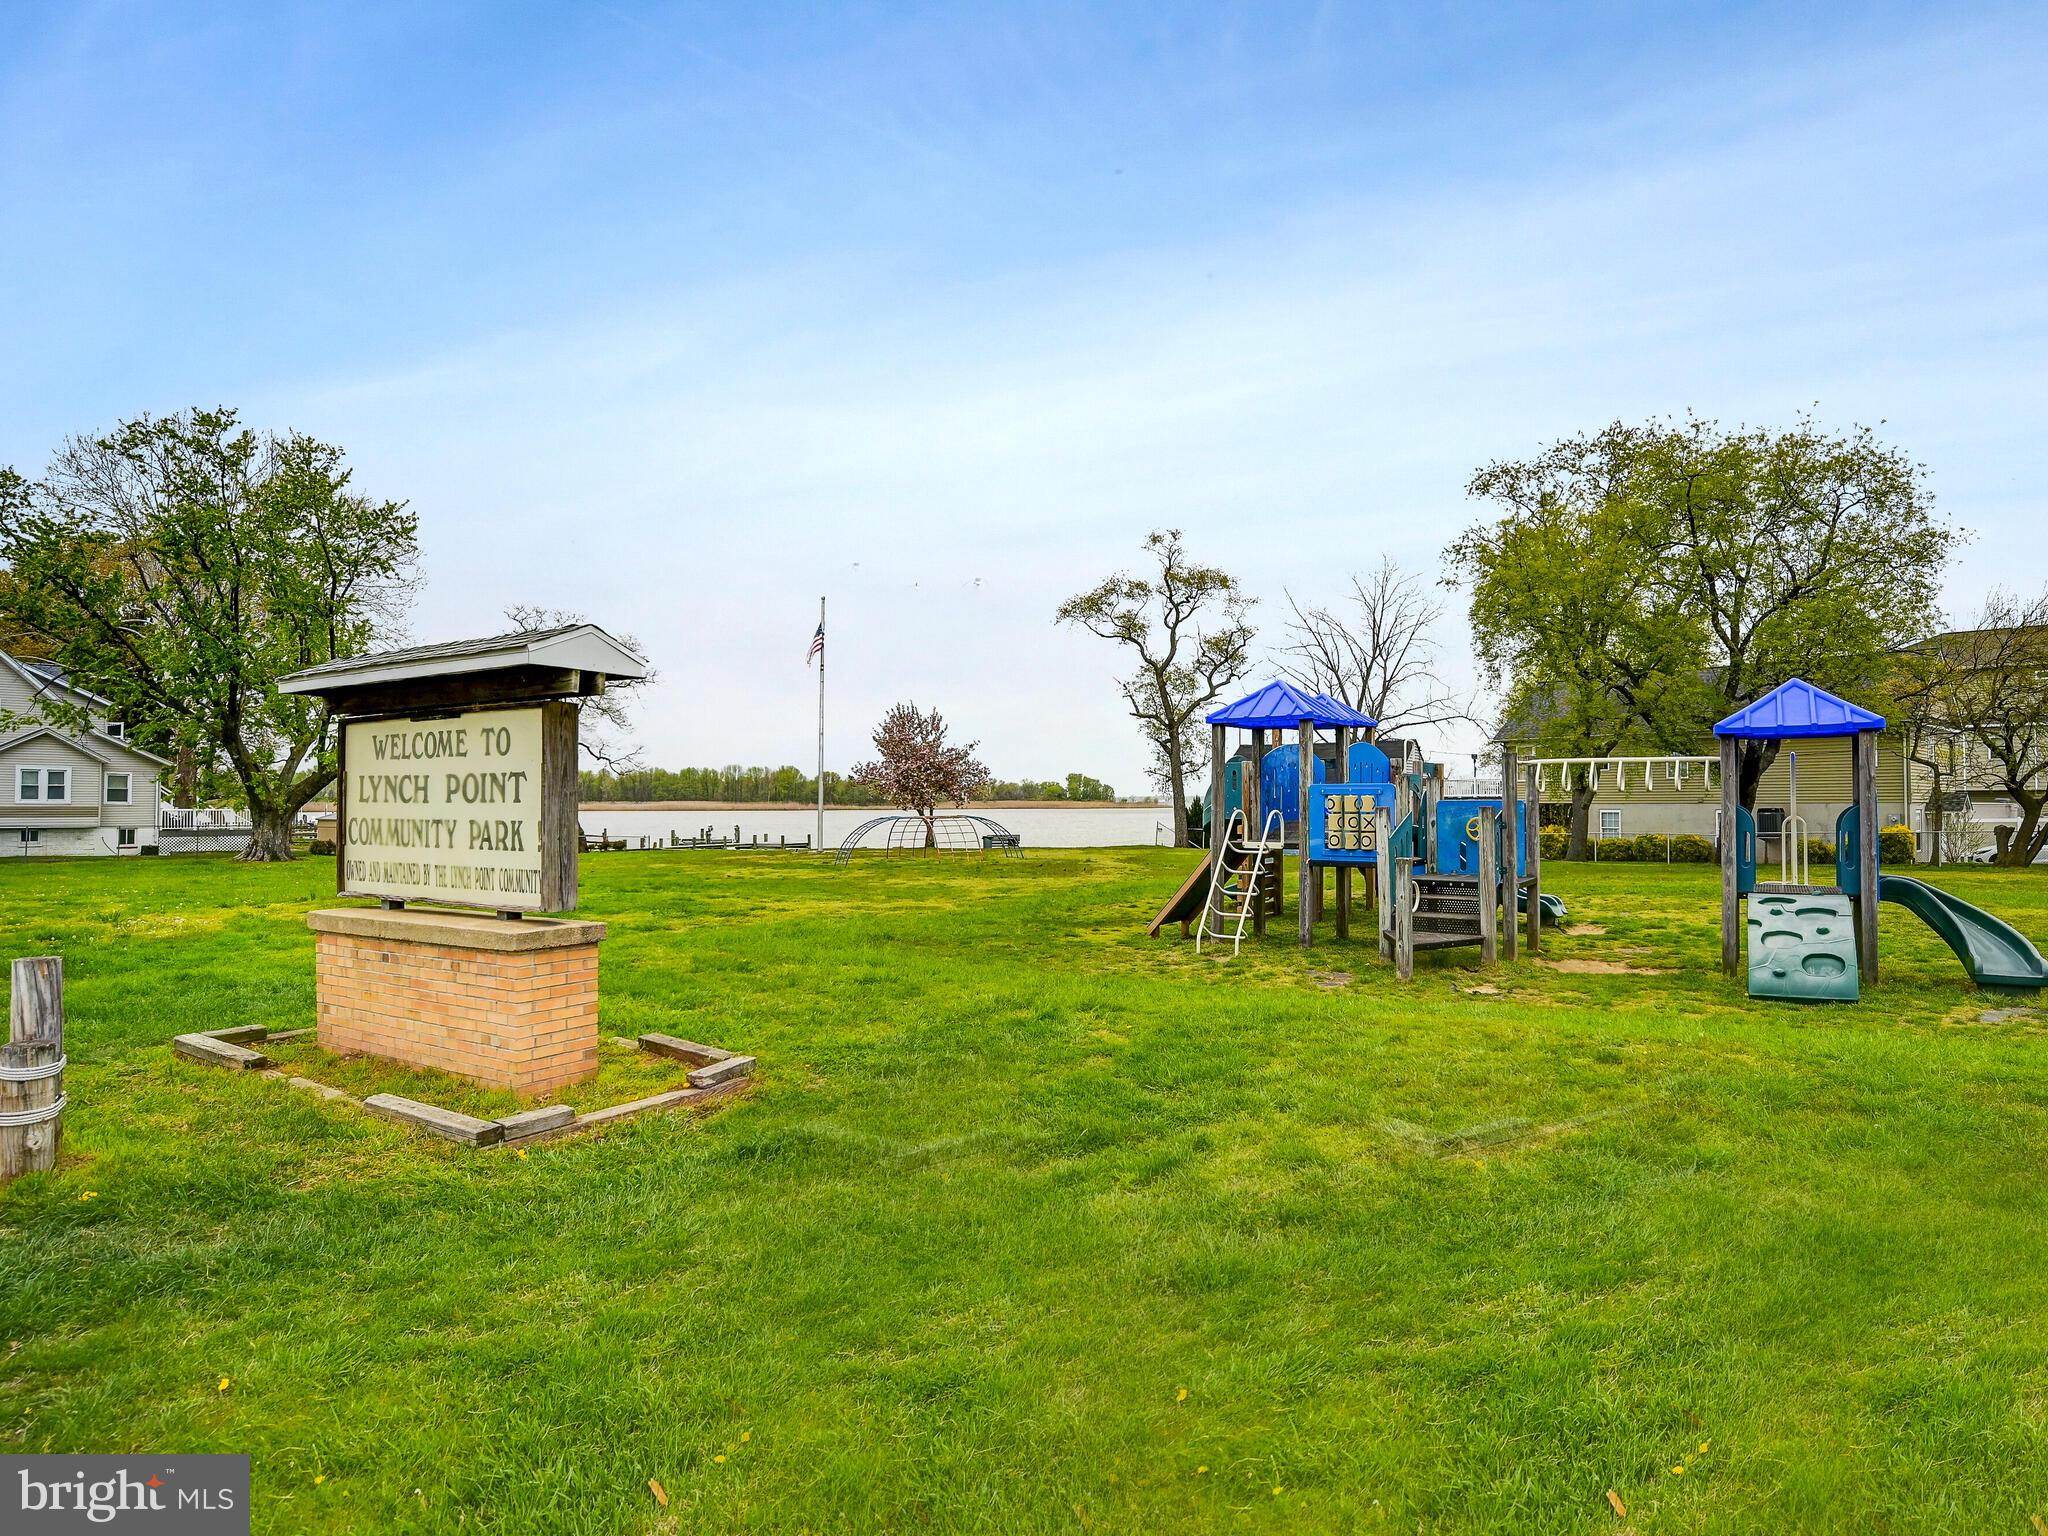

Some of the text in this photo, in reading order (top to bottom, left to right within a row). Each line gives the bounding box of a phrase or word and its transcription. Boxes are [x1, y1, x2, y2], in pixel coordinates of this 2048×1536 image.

[372, 726, 511, 760] WELCOME TO
[358, 771, 528, 804] LYNCH POINT
[348, 817, 457, 849] COMMUNITY
[468, 819, 525, 852] PARK
[346, 859, 367, 882] OWNED
[369, 861, 381, 883] AND
[383, 861, 421, 886] MAINTAINED
[423, 863, 431, 887] BY
[434, 864, 448, 888] THE
[450, 865, 472, 890] LYNCH
[475, 866, 496, 892] POINT
